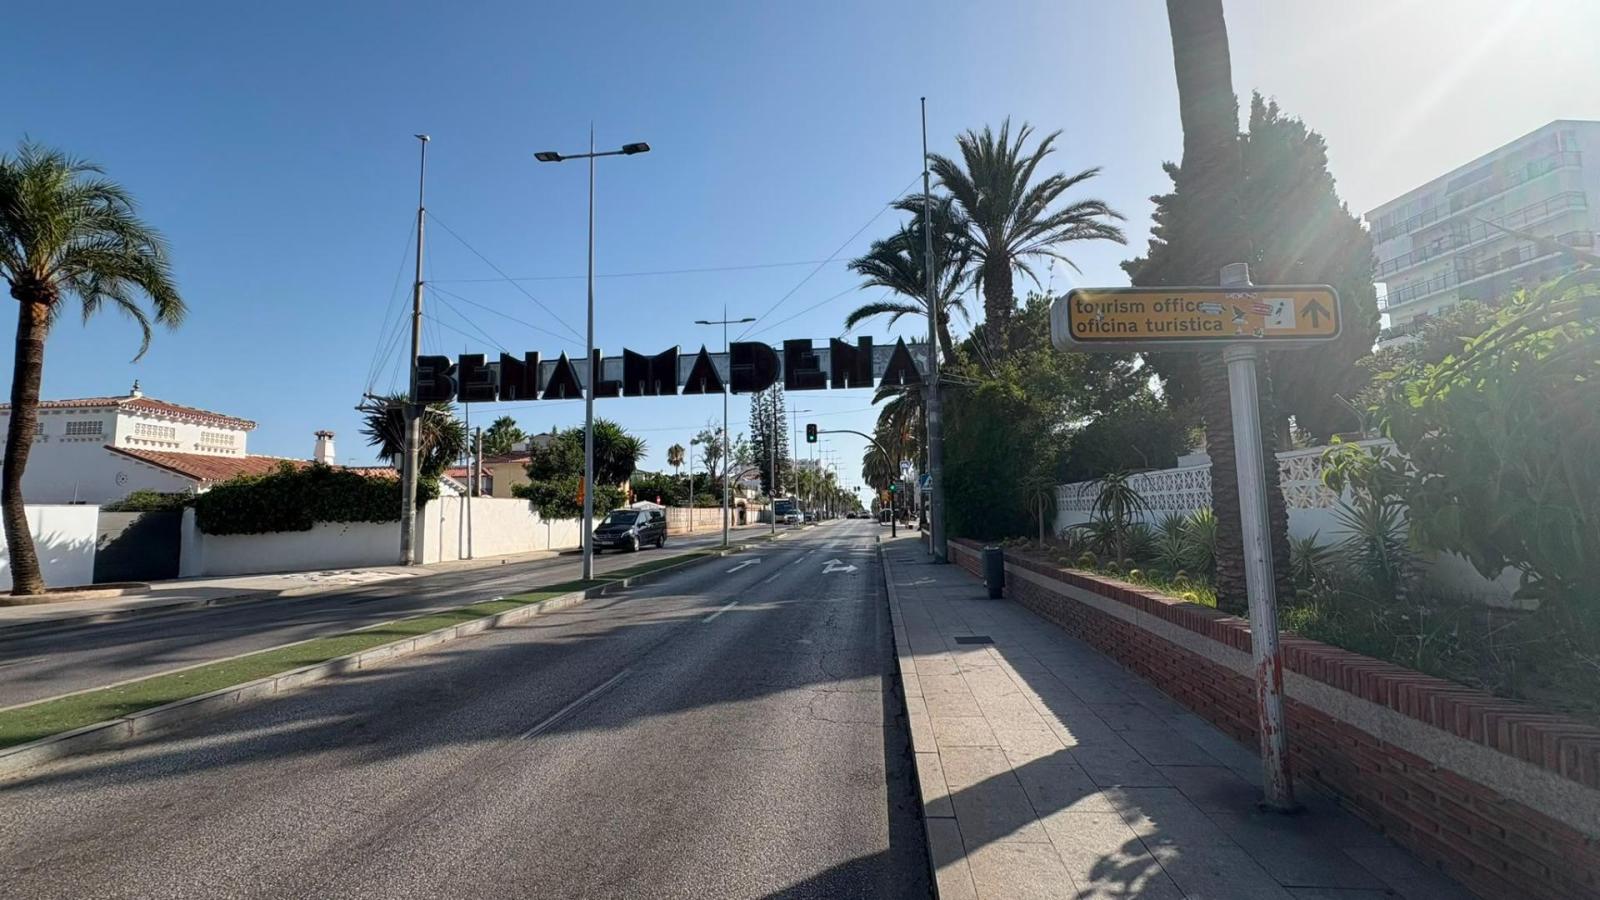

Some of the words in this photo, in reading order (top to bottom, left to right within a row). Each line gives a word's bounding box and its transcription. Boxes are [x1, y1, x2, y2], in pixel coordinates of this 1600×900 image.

[1075, 300, 1145, 314] tourism
[1076, 318, 1138, 333] oficina
[416, 336, 924, 402] BENALMADENA
